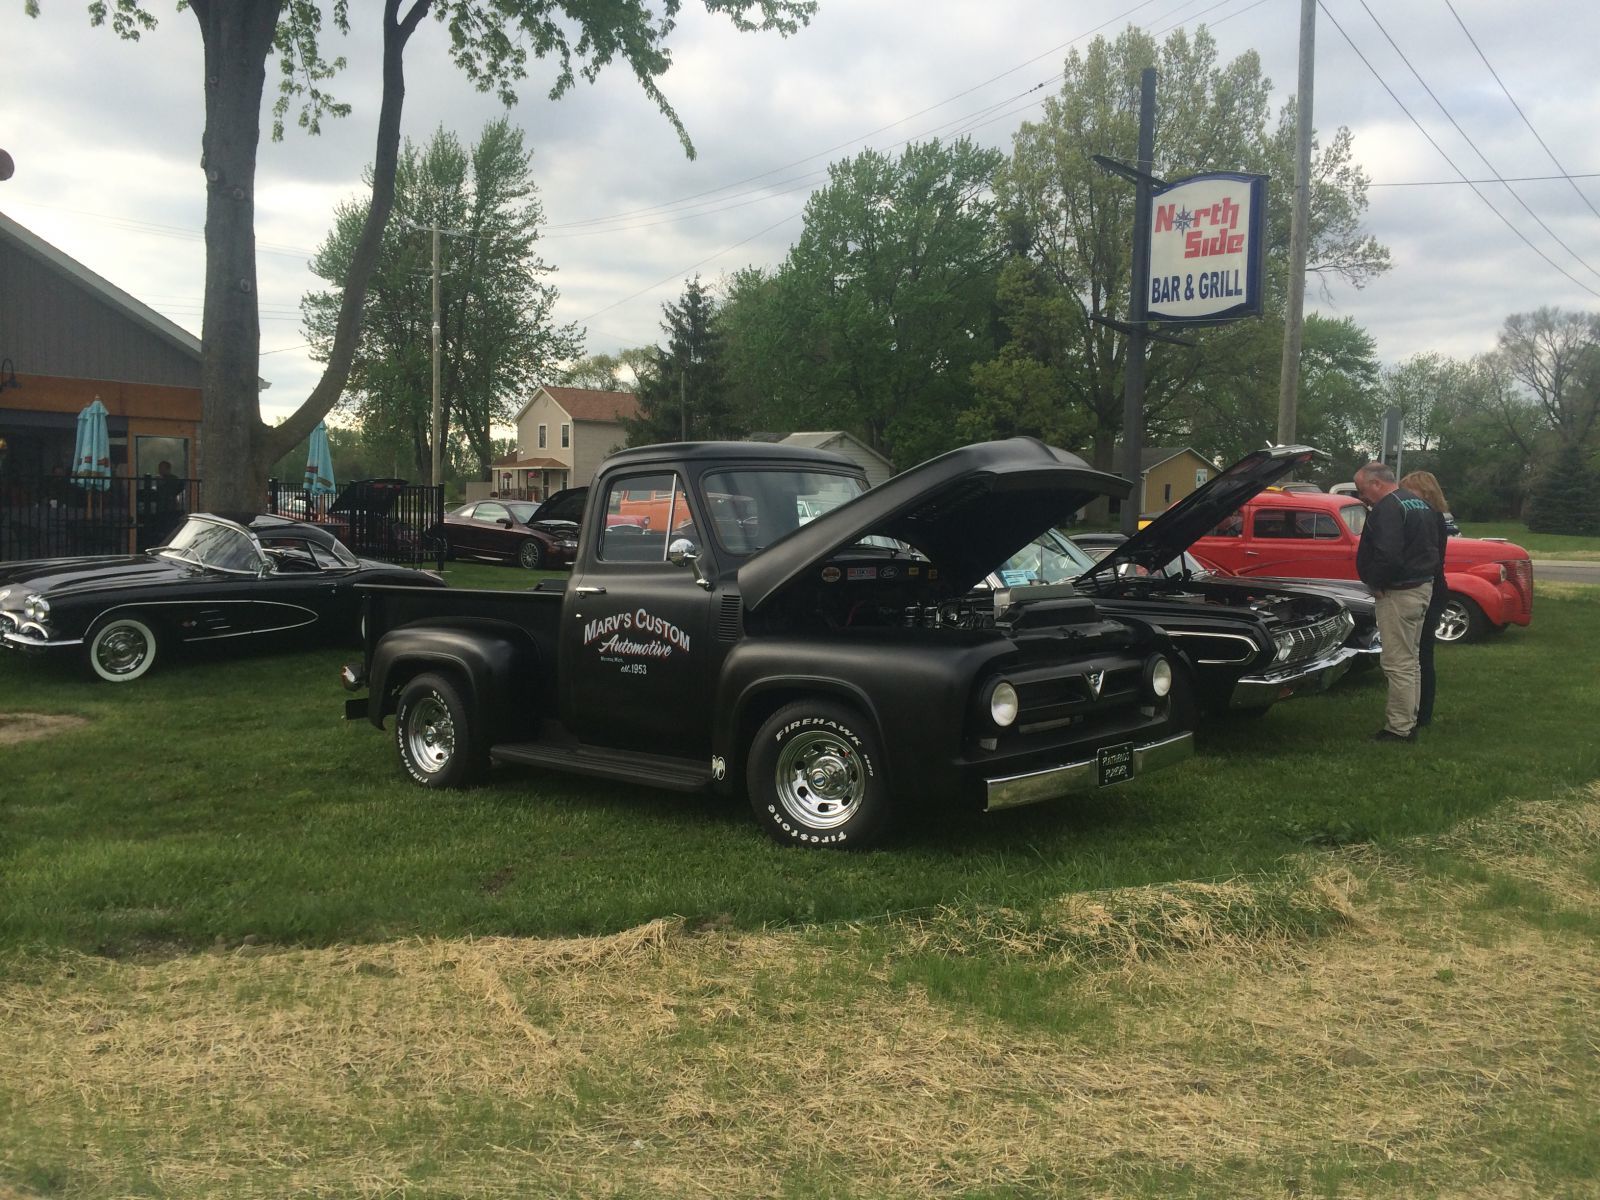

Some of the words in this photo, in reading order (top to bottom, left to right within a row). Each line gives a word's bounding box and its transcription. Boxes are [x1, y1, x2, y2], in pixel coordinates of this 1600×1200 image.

[1152, 275, 1181, 304] BAR
[1184, 273, 1195, 301] &
[1199, 269, 1243, 300] GRILL
[583, 612, 632, 645] MARV'S
[635, 608, 691, 652] CUSTOM
[598, 633, 673, 657] Automotive
[631, 663, 647, 675] 1953
[775, 717, 862, 747] FIREHAWK
[767, 804, 848, 844] Firestone
